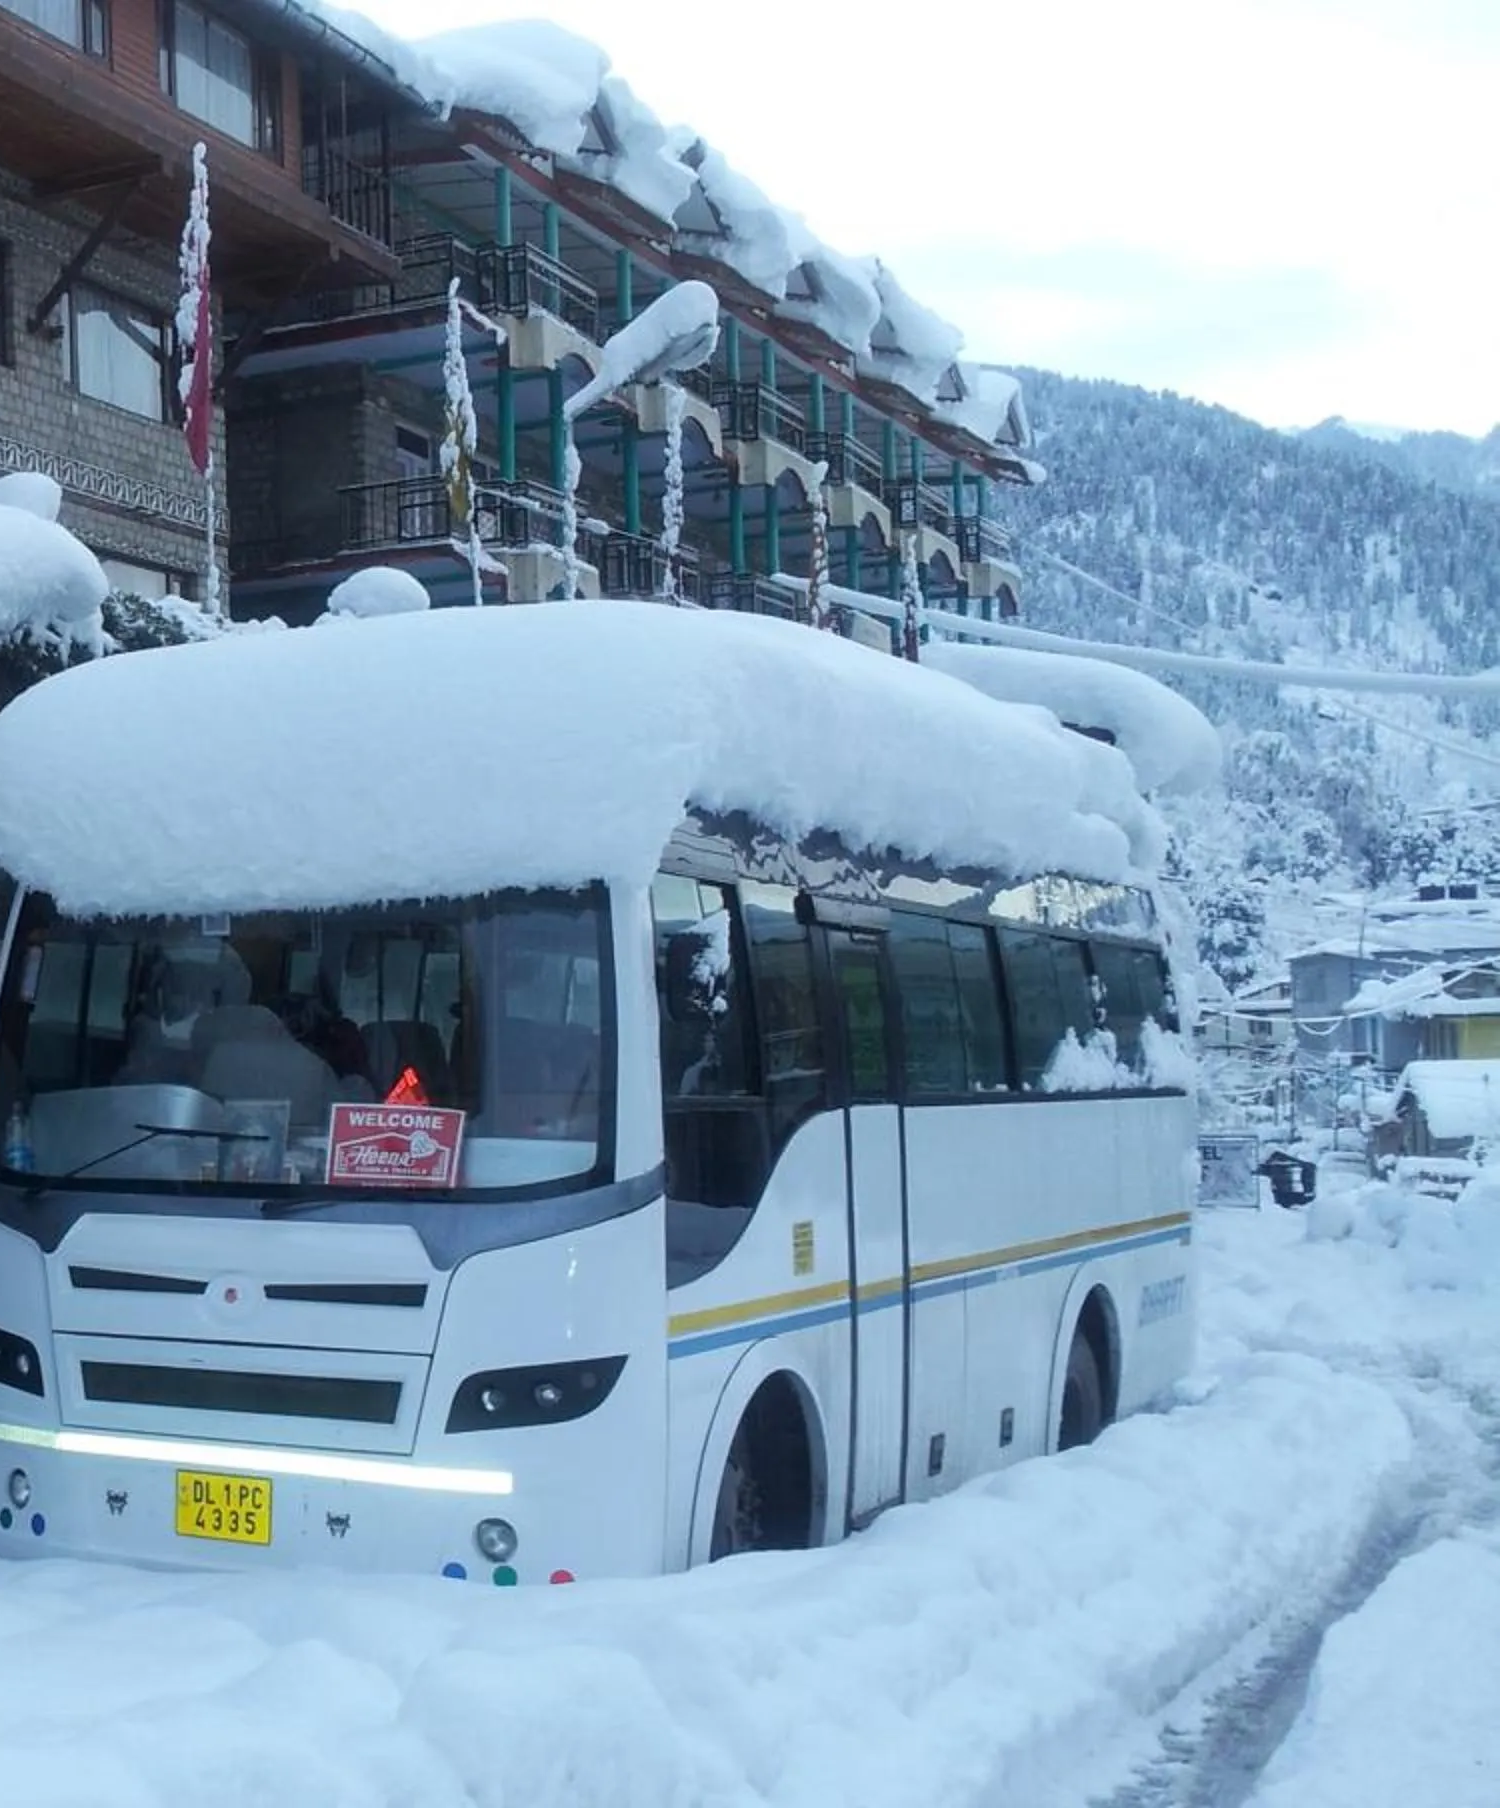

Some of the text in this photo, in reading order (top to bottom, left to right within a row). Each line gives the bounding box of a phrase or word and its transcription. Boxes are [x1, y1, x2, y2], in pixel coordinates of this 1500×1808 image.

[349, 1111, 445, 1129] WELCOME
[193, 1479, 216, 1505] DL
[195, 1507, 257, 1535] 4335
